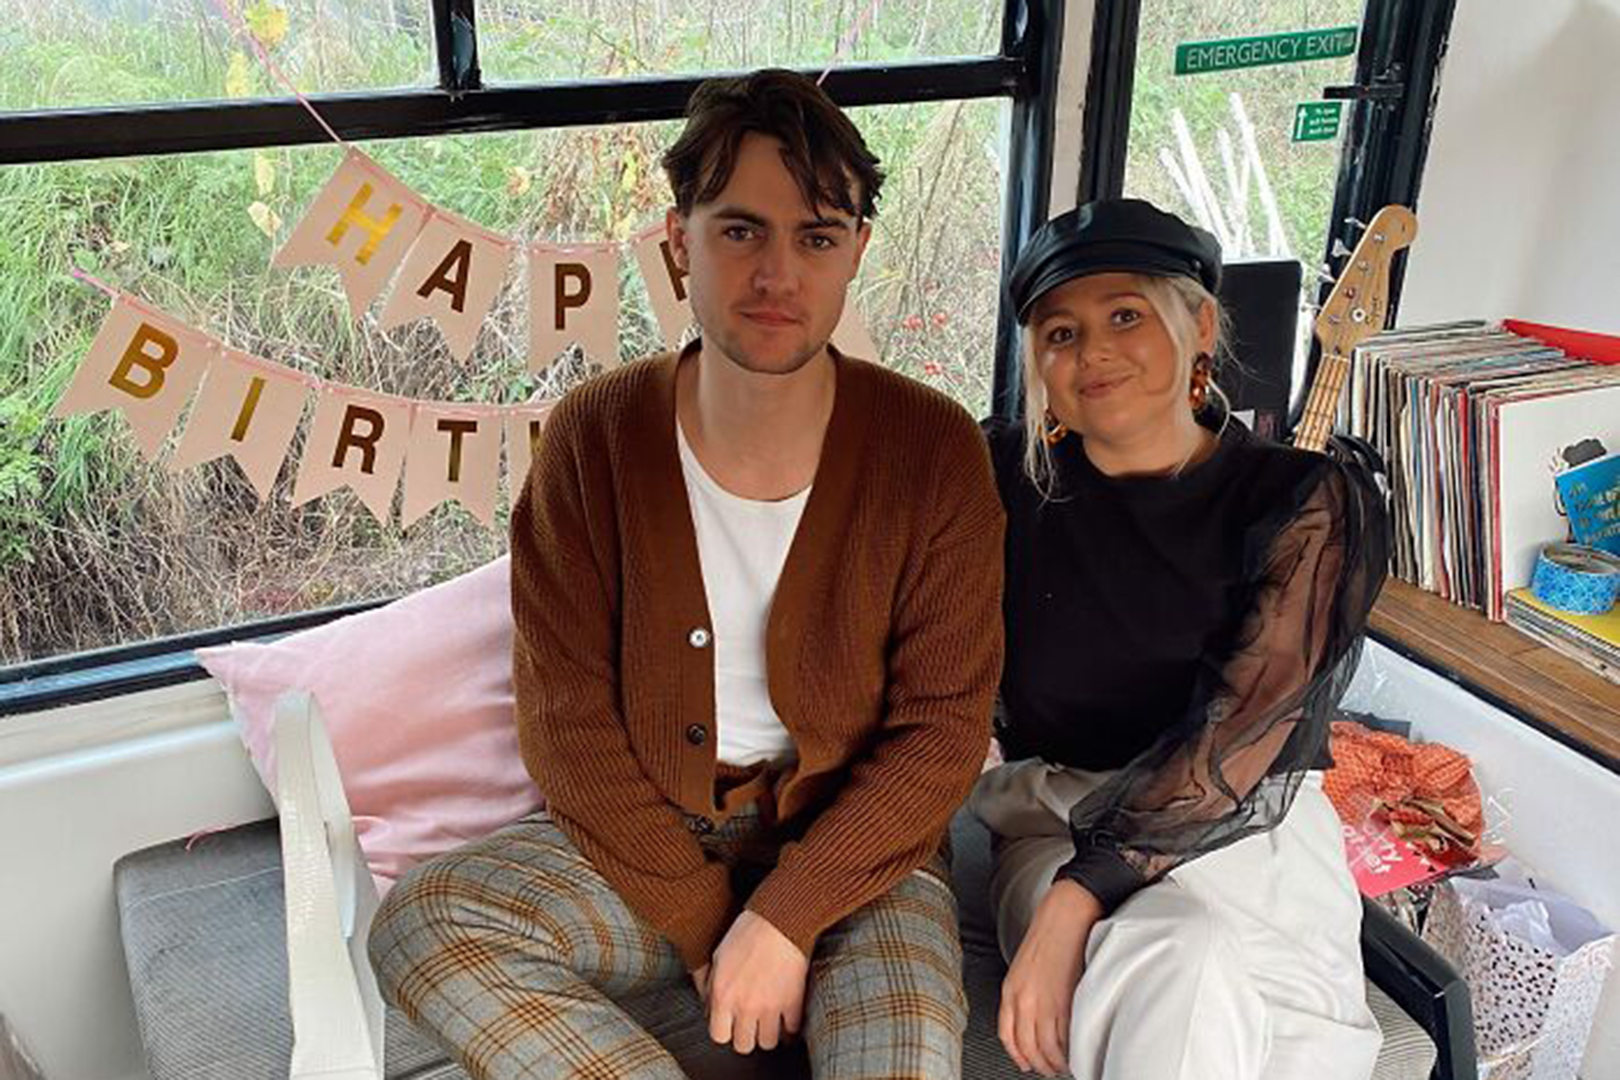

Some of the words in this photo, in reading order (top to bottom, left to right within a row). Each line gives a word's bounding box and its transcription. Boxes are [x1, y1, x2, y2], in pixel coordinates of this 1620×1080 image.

[1186, 39, 1301, 69] EMERGENCY
[1306, 33, 1347, 56] EXIT
[108, 322, 542, 482] BIRT
